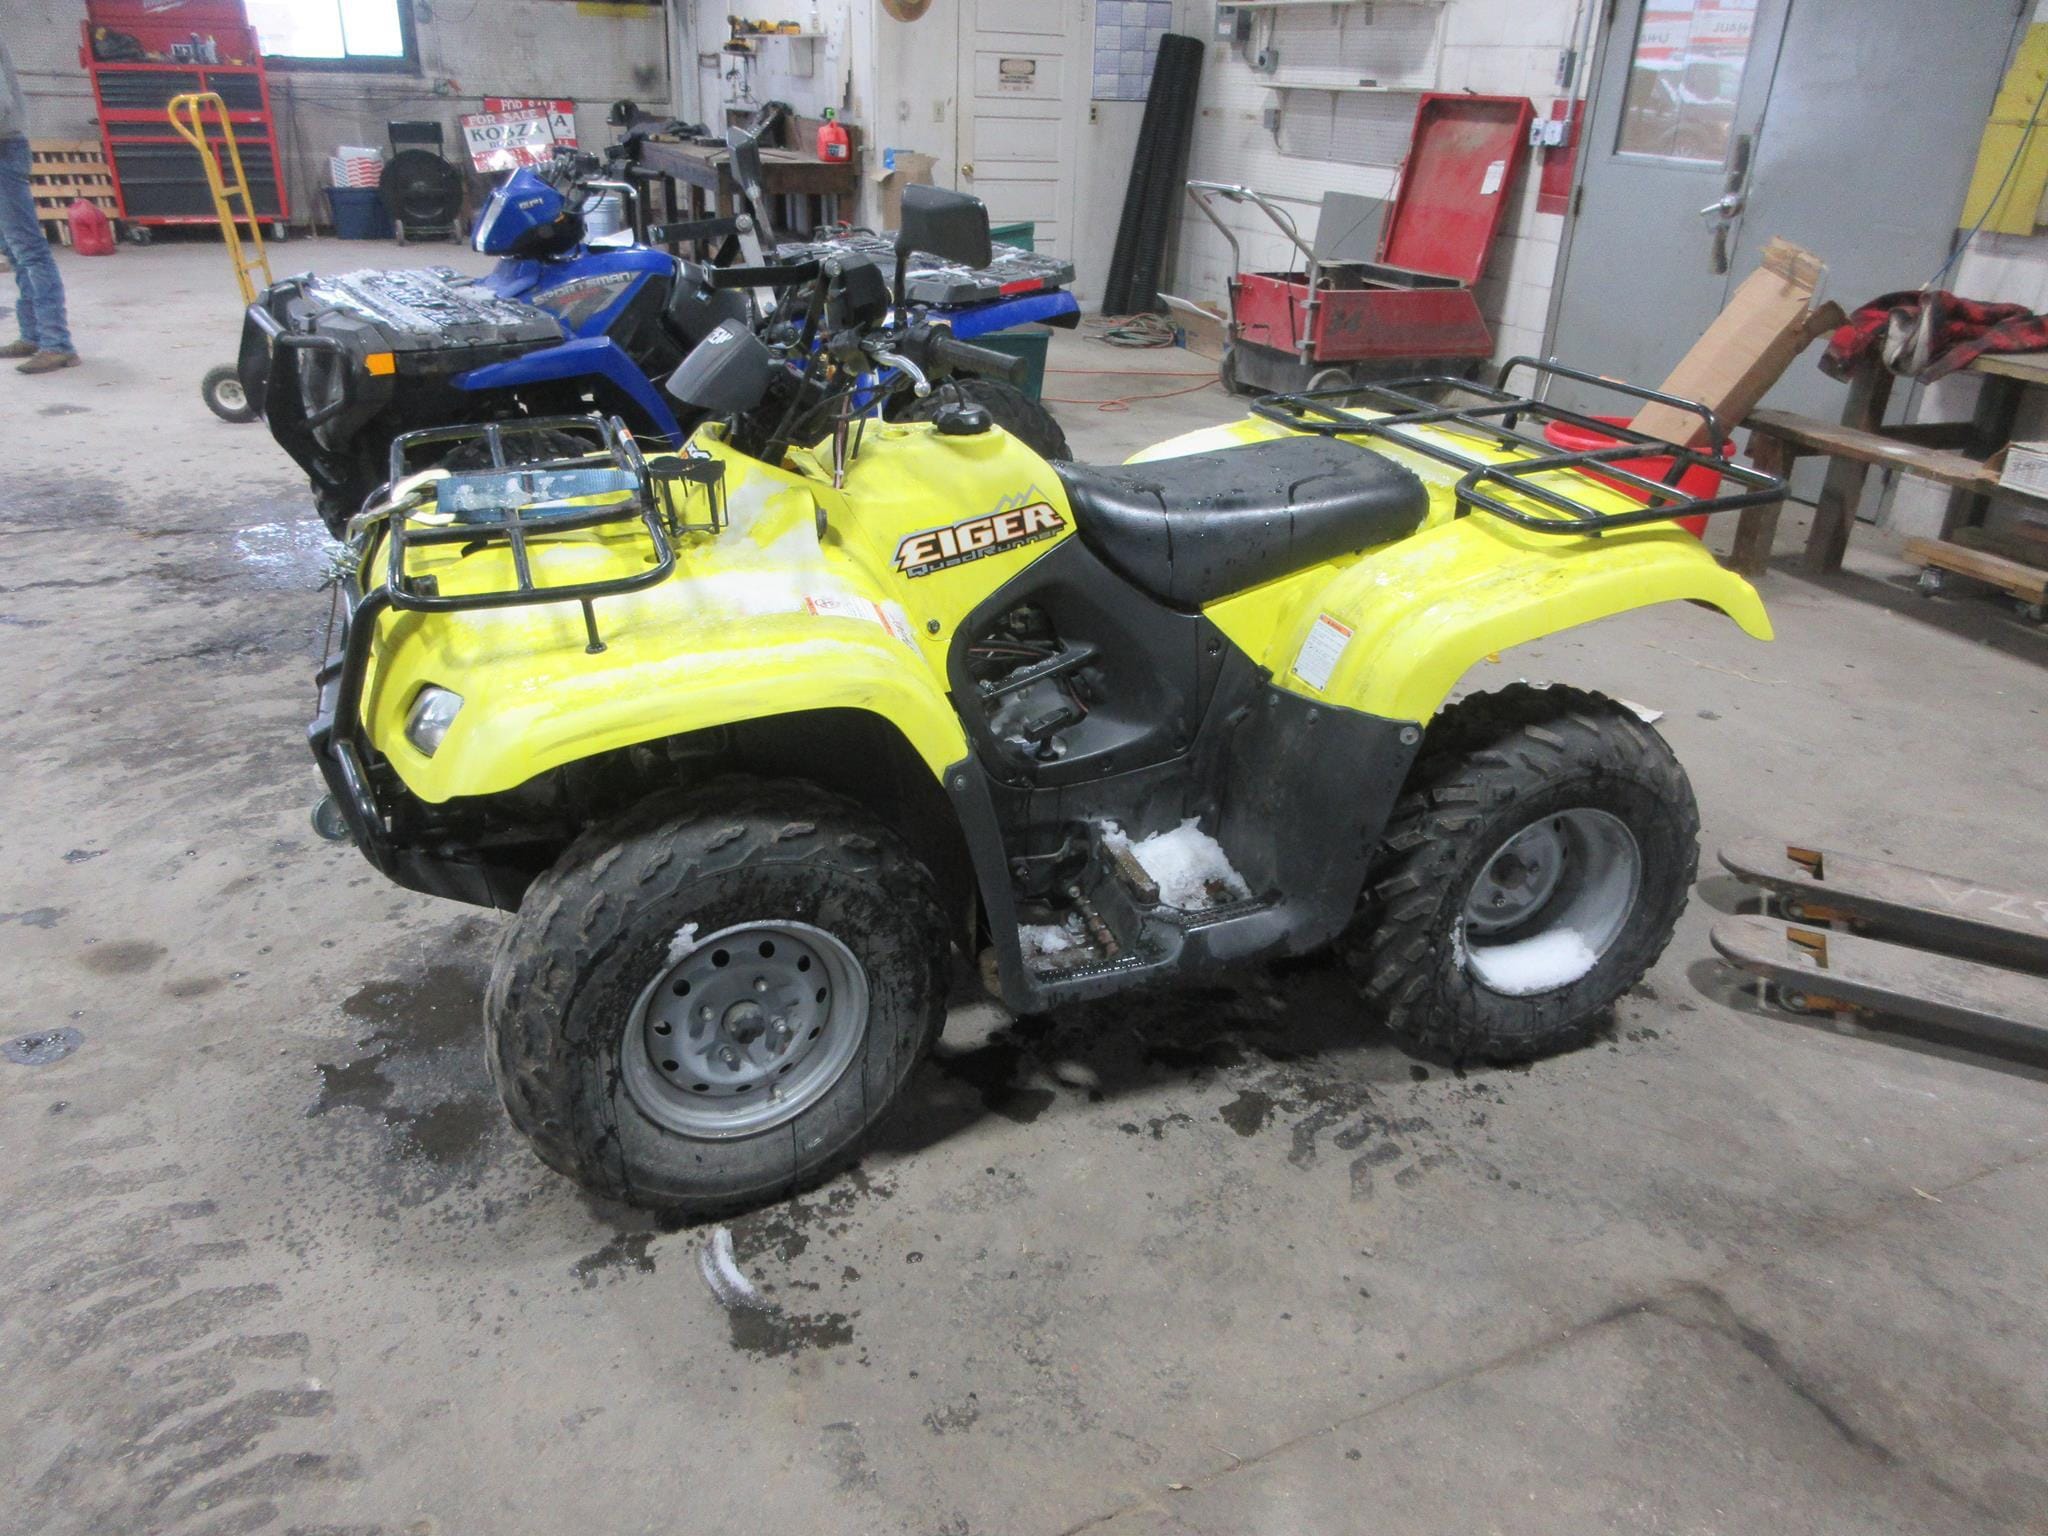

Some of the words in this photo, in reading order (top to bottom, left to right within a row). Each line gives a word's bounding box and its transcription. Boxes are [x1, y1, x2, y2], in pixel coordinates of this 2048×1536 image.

[469, 114, 496, 126] FOR
[502, 108, 538, 122] SALE
[898, 503, 1066, 571] EIGER
